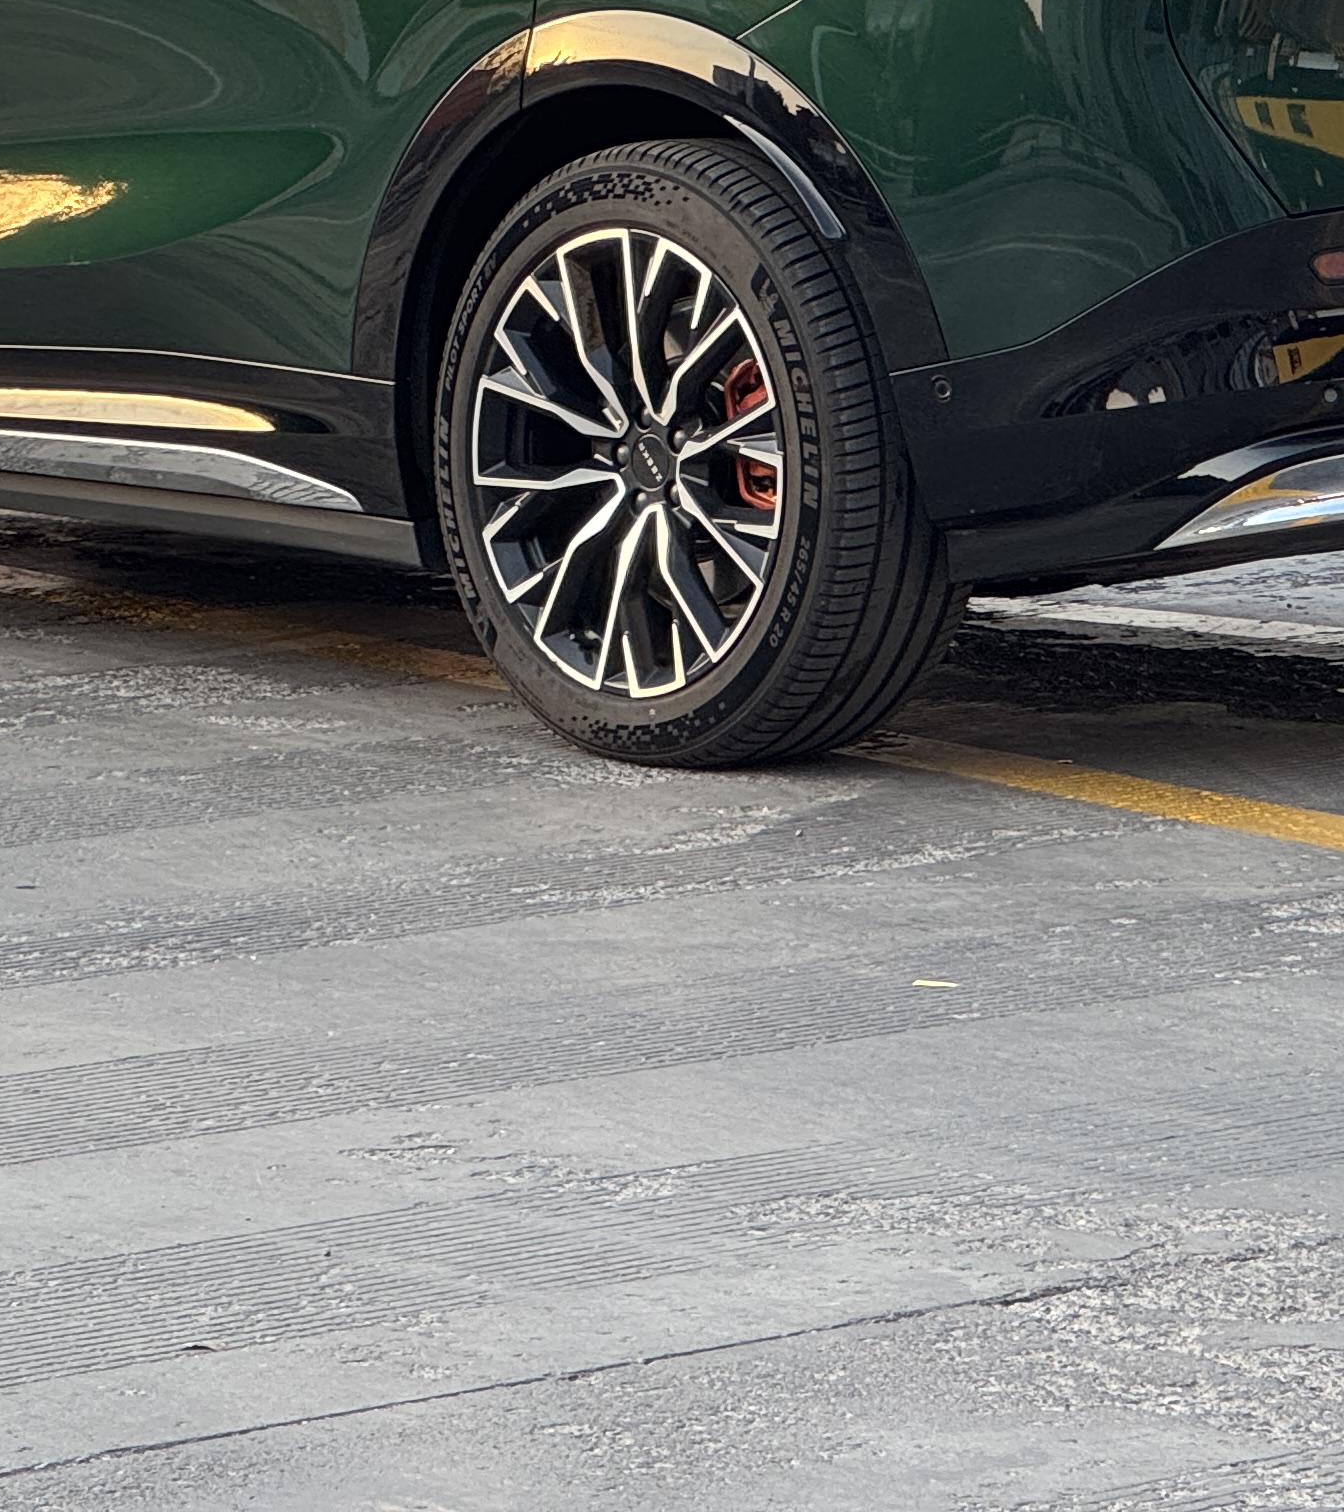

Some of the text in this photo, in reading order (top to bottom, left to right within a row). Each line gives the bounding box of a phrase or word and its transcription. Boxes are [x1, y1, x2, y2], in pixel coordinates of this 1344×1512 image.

[445, 335, 460, 391] PILOT
[459, 275, 483, 336] SPORT
[772, 318, 819, 510] MICHELIN
[439, 416, 476, 599] MICHELIN
[787, 535, 811, 607] 265/45
[769, 623, 784, 648] 20
